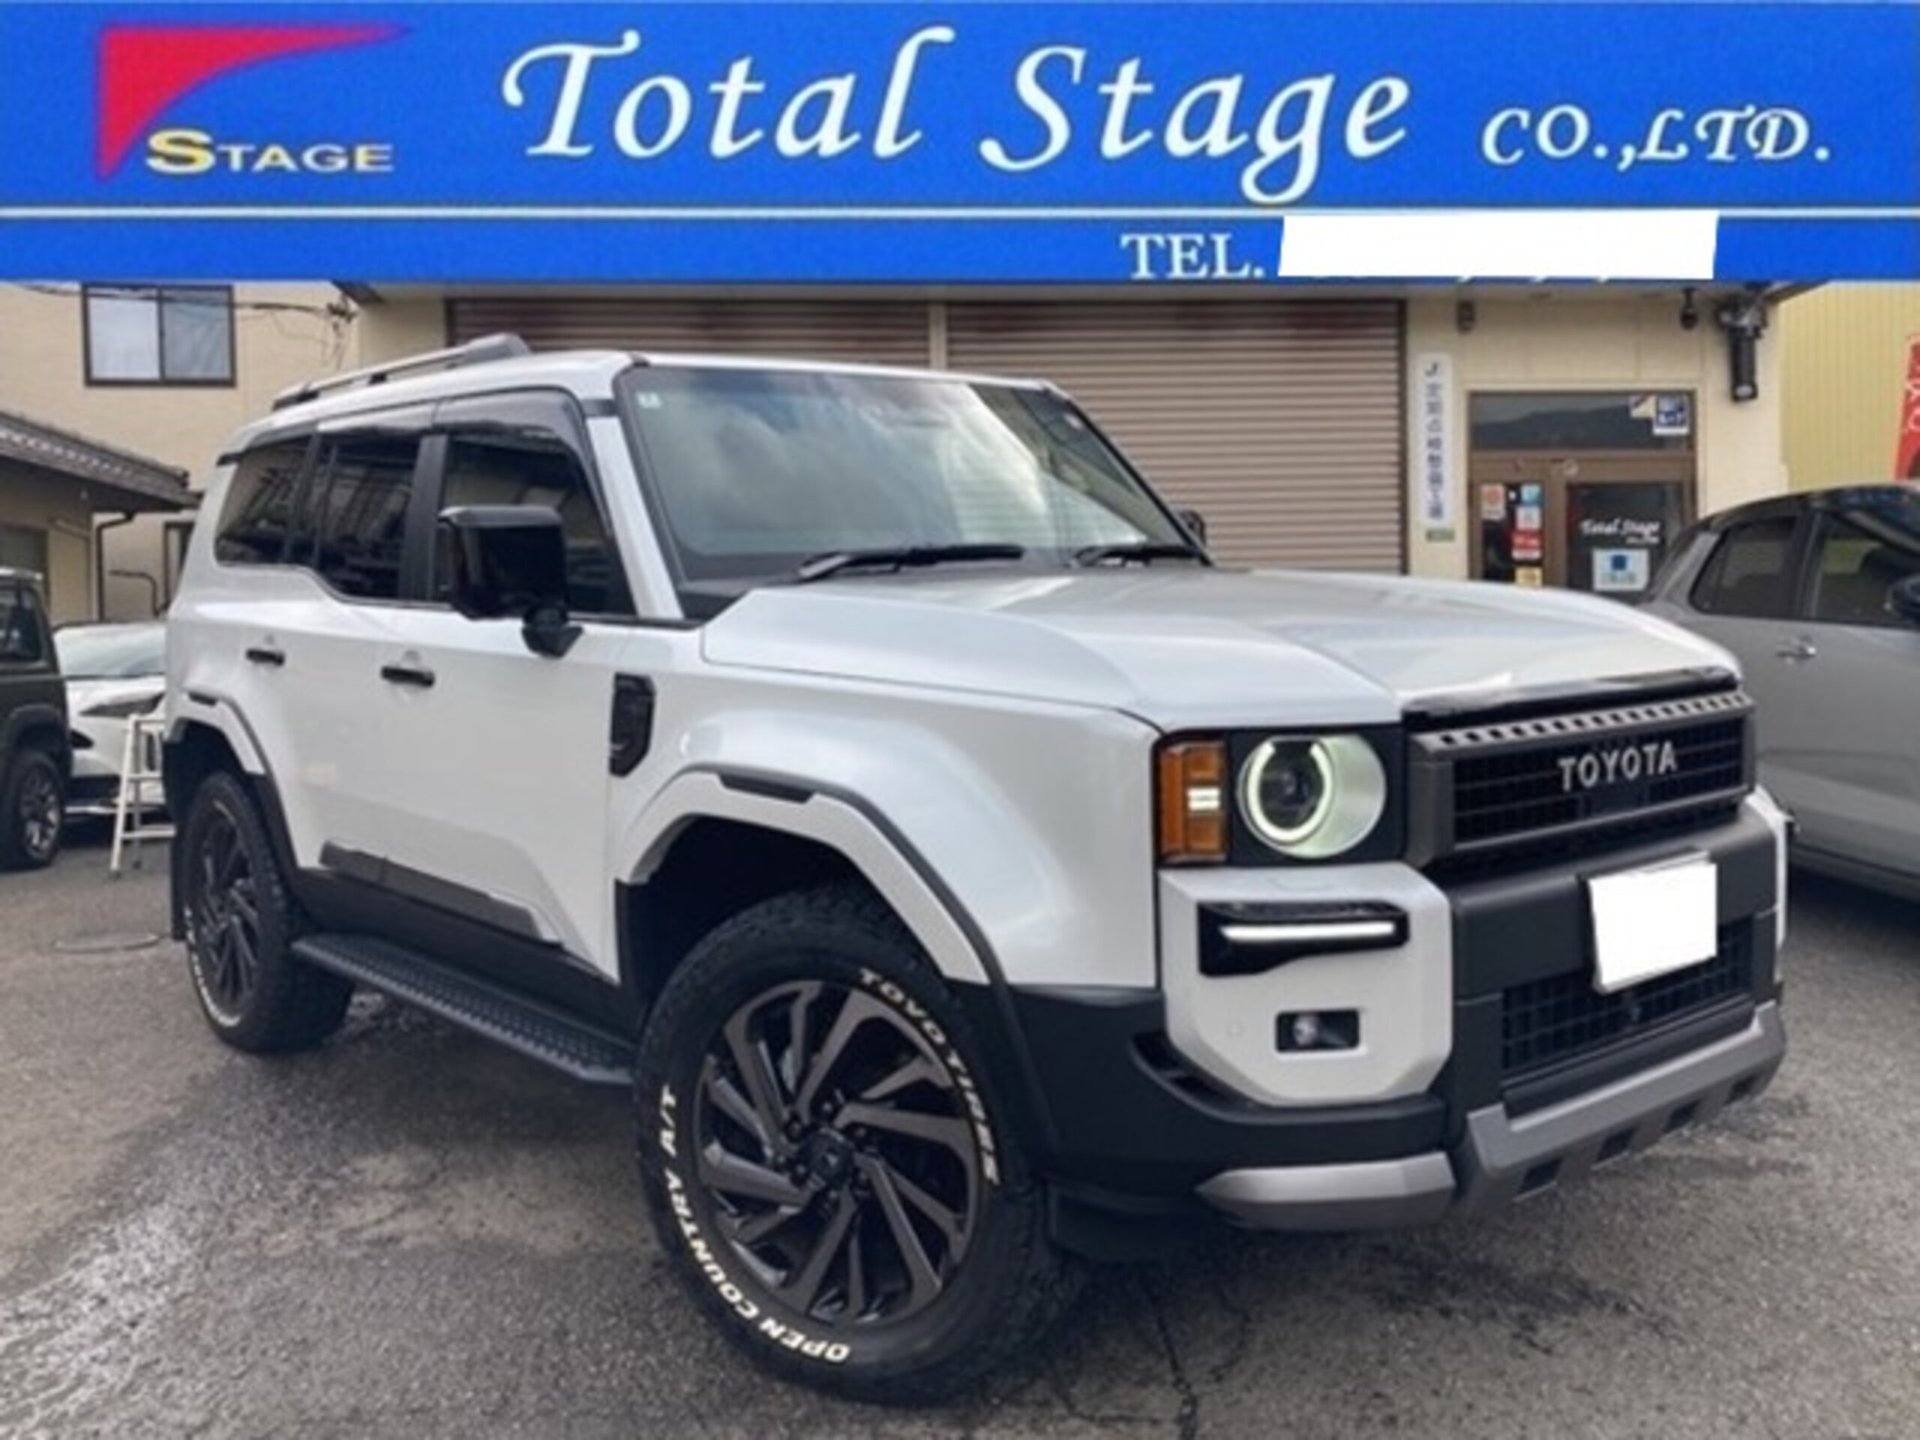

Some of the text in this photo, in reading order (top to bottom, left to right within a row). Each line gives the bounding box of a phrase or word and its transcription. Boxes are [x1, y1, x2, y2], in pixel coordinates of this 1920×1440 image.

[145, 128, 394, 175] STAGE
[502, 28, 956, 159] Total
[979, 45, 1410, 204] Stage
[1120, 233, 1265, 280] TEL.
[1557, 741, 1678, 793] TOYOTA
[859, 968, 1000, 1185] TOYO TIRES
[659, 1084, 851, 1364] OPEN COUNTRY A/T
